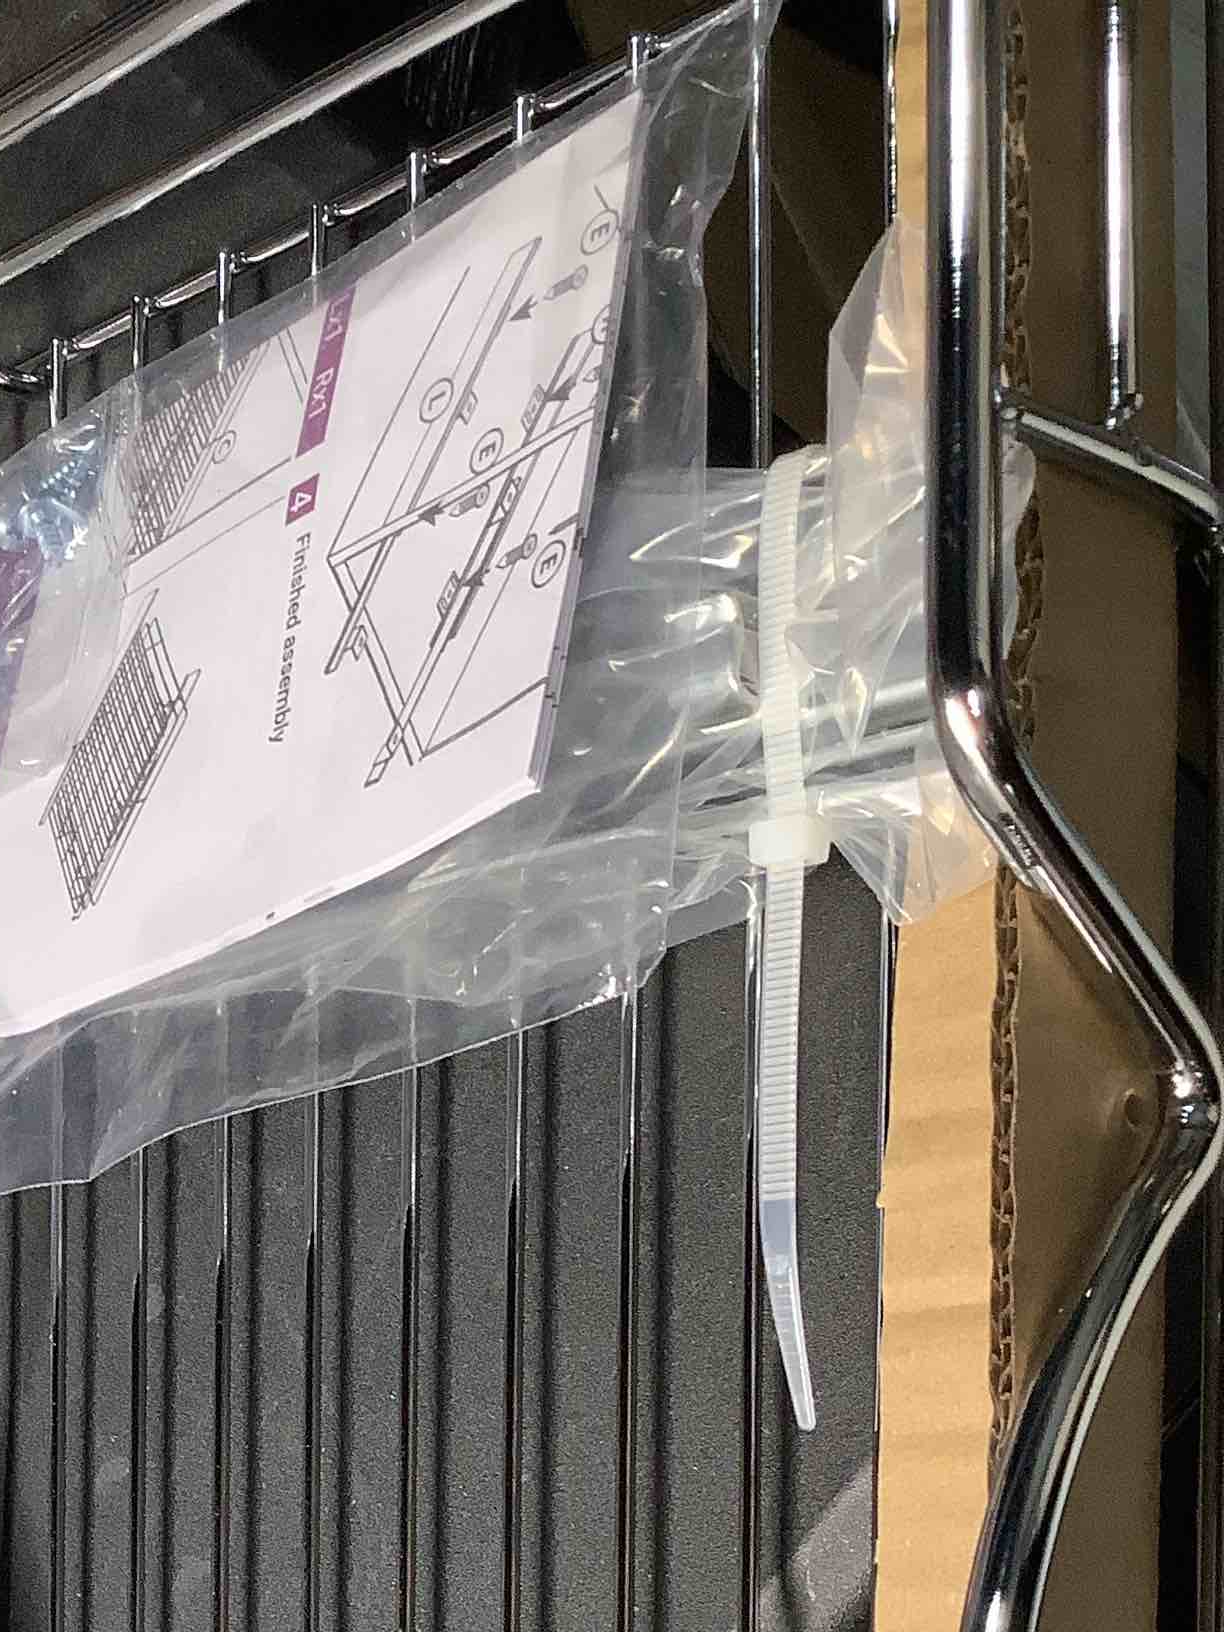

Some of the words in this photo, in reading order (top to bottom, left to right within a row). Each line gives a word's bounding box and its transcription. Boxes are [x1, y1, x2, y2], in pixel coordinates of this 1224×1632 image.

[308, 366, 335, 420] Rx1
[291, 489, 312, 513] 4
[286, 532, 313, 628] Finished
[267, 635, 299, 744] assembly
